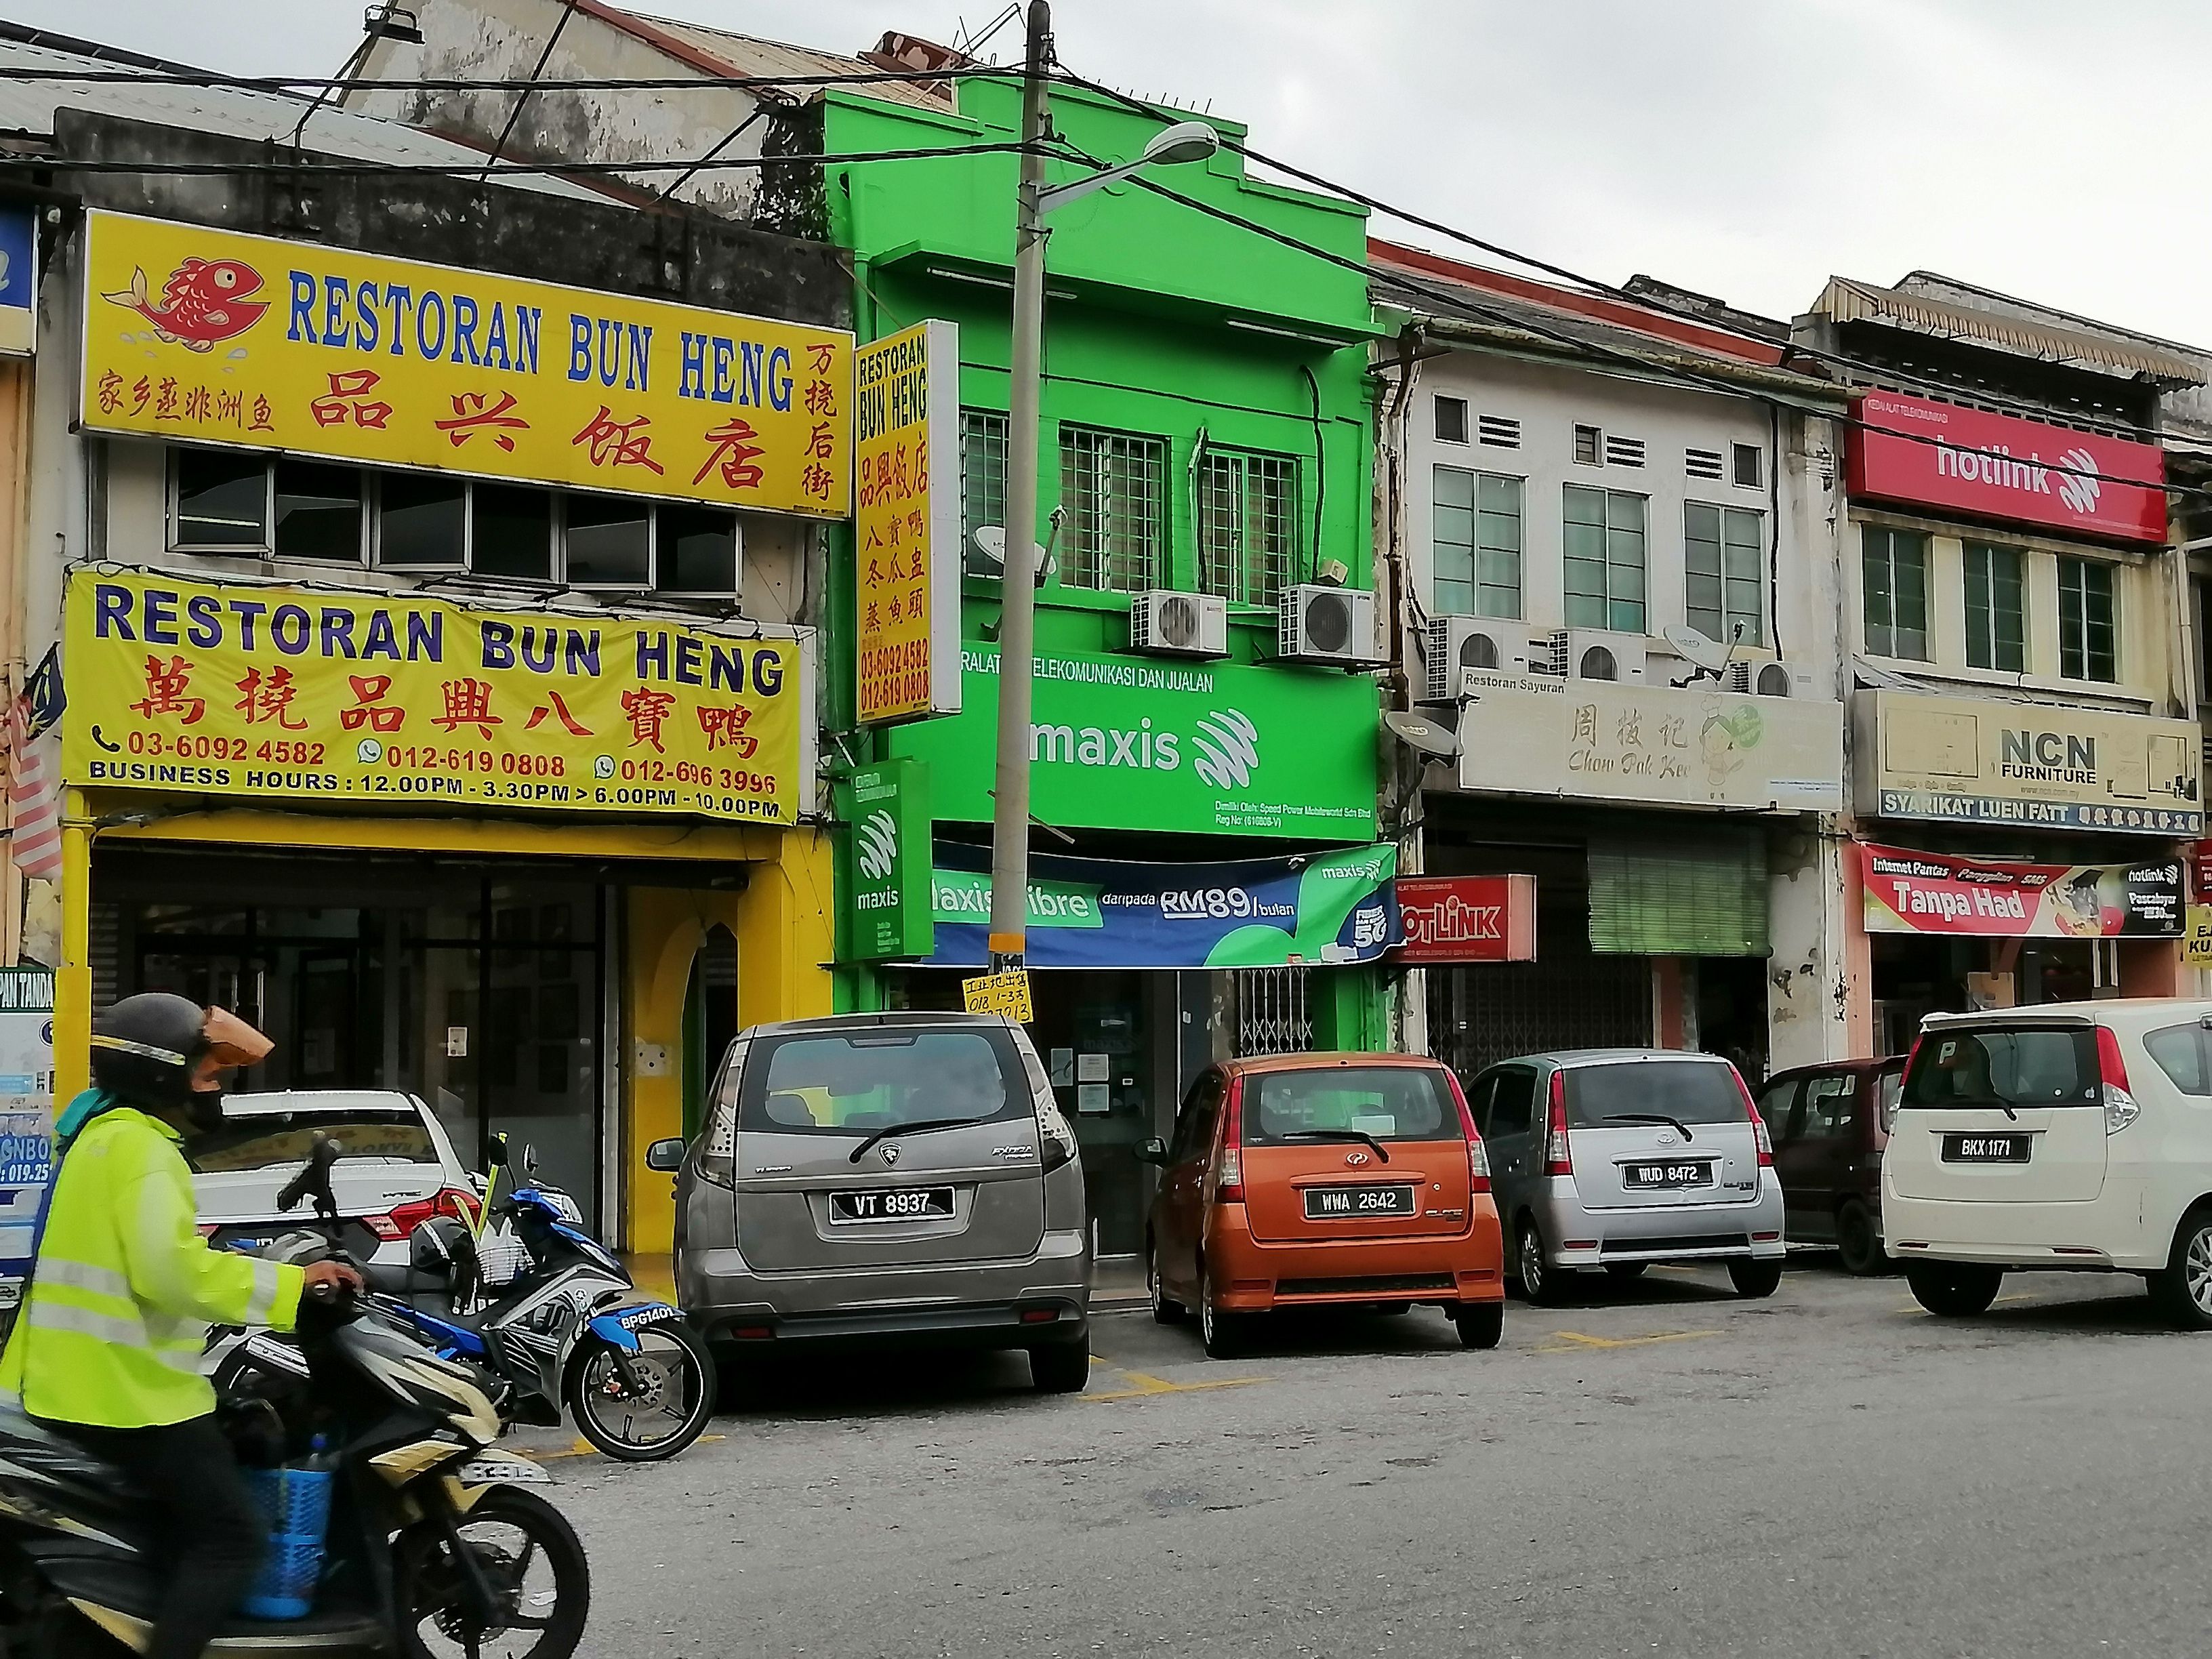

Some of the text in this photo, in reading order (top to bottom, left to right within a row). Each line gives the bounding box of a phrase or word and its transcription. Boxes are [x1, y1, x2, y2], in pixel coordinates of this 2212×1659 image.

[287, 270, 794, 413] RESTORAN BUN HENG
[859, 333, 925, 387] RESTORAN
[97, 369, 275, 432] 家乡蒸非洲鱼
[860, 367, 927, 442] BUN HENG
[310, 369, 766, 489] 品兴饭店
[1936, 434, 2051, 495] hotlink
[95, 583, 784, 697] RESTORAN BUN HENG
[903, 638, 928, 672] 4582
[903, 670, 929, 703] 0808
[1031, 657, 1136, 687] ELEKOMUNIKASI
[1137, 669, 1164, 689] DAN
[1166, 671, 1213, 693] JUALAN
[1465, 673, 1565, 693] Restoran Sayuran
[1029, 717, 1180, 771] maxis
[2001, 729, 2096, 770] NCN
[127, 731, 776, 795] 03-6092 4582 012-619 0808 012-696 3996
[2001, 764, 2097, 785] FURNITURE
[89, 760, 230, 786] BUSINESS
[360, 775, 463, 796] 12.00PM
[483, 781, 569, 801] 3.30PM
[594, 787, 676, 806] 6.00PM
[696, 793, 780, 819] 10.00PM
[1884, 794, 1974, 816] SYARIKAT
[1979, 800, 2024, 820] LUEN
[2028, 803, 2069, 822] FATT
[1322, 863, 1366, 879] maxis
[1873, 857, 1912, 874] Internet
[1913, 861, 1950, 877] Pantas
[857, 884, 899, 909] maxis
[1026, 885, 1089, 918] ibre
[1102, 890, 1155, 907] daripada
[1892, 881, 2026, 922] Tanpa Had
[969, 996, 989, 1011] 018
[1938, 1042, 1956, 1065] P
[1961, 1139, 2011, 1156] BKX 1171
[1667, 1166, 1698, 1181] 8472
[855, 1193, 930, 1215] VT 8937
[1322, 1192, 1398, 1210] WWA 2642
[621, 1307, 675, 1330] BPG1401
